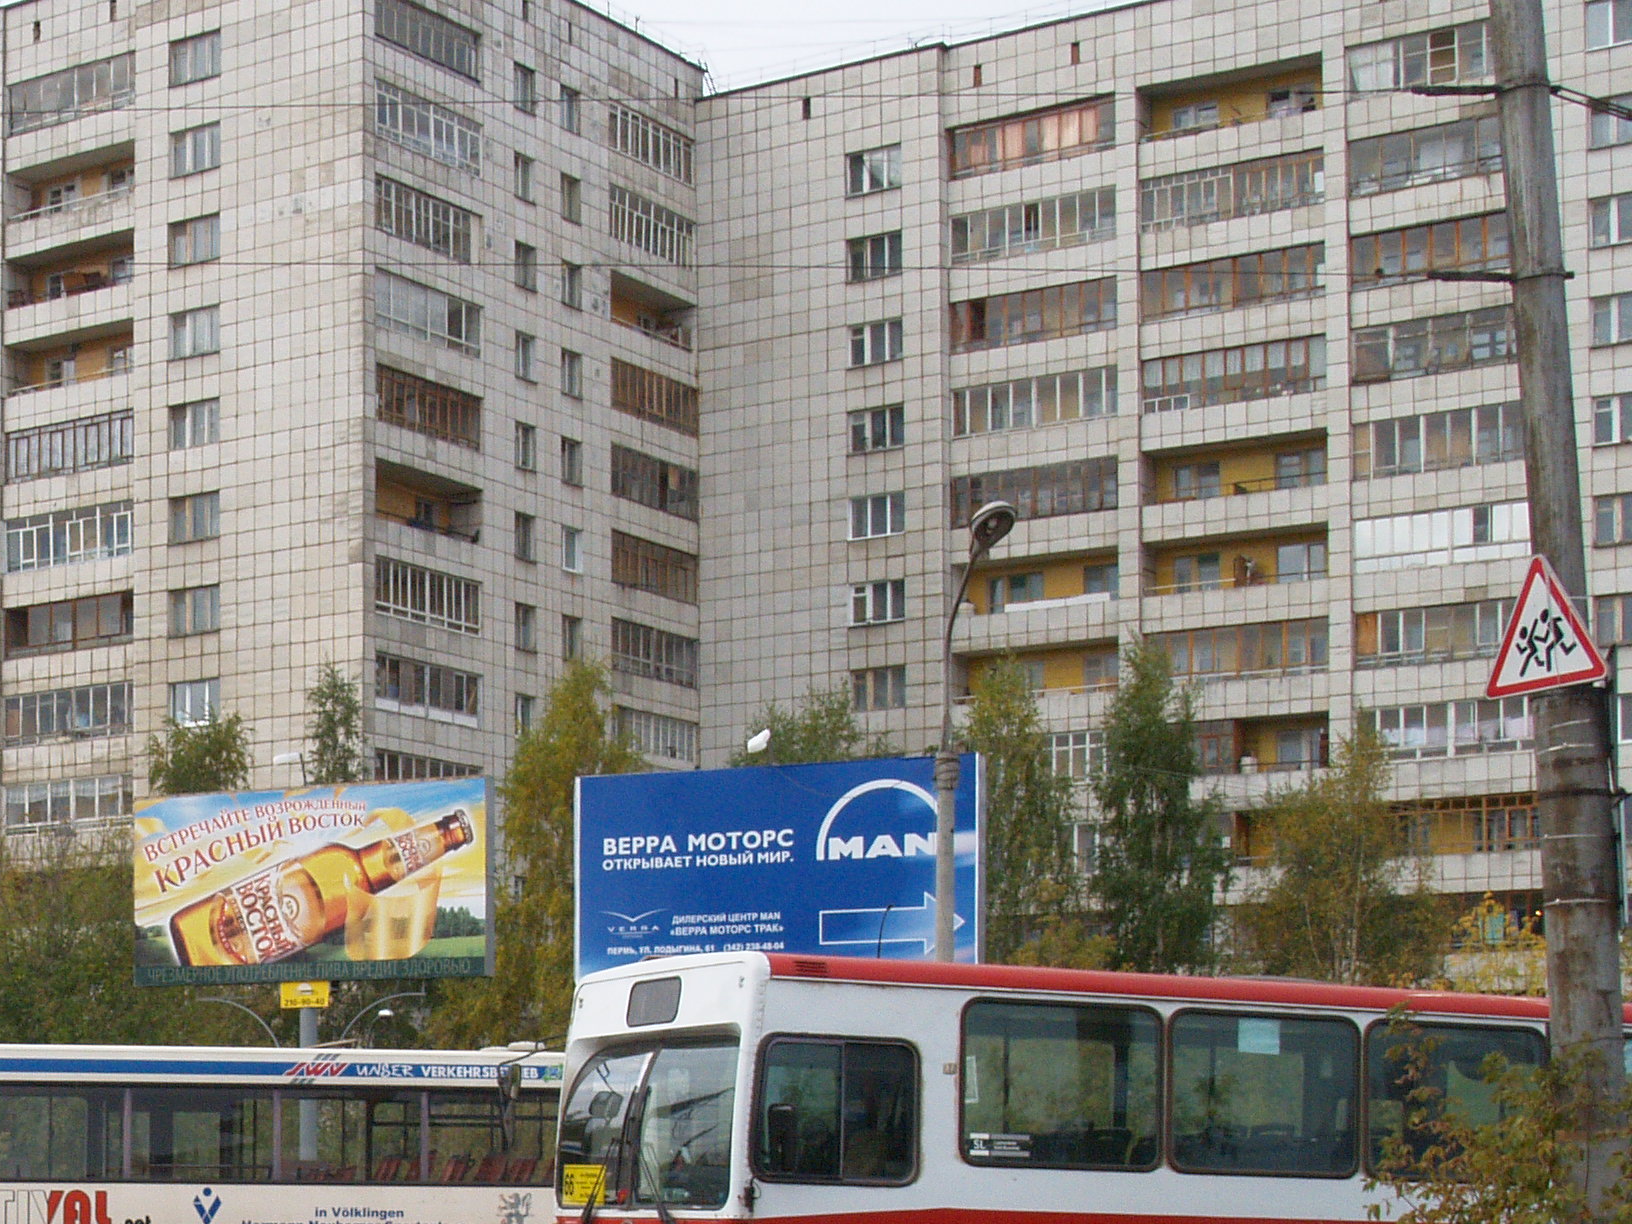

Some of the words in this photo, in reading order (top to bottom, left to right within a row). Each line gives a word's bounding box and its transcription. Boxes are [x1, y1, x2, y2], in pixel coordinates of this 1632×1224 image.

[144, 809, 251, 861] ВСТРЕЧАЙТЕ
[603, 837, 677, 856] ВЕРРА
[687, 829, 794, 852] МОТОРС
[827, 832, 937, 860] MAN
[153, 815, 283, 893] КРАСНЫЙ
[288, 813, 366, 835] ВОСТОК
[602, 855, 691, 871] ОТКРЫВАЕТ
[696, 850, 754, 867] НОВЫЙ
[757, 850, 794, 864] МИР.
[671, 913, 727, 925] ДИЛЕРСКИЙ
[728, 912, 758, 924] ЦЕНТР
[759, 911, 780, 921] MAN
[709, 924, 751, 935] МОТОРС
[314, 1207, 327, 1218] in
[331, 1206, 404, 1220] Völklingen
